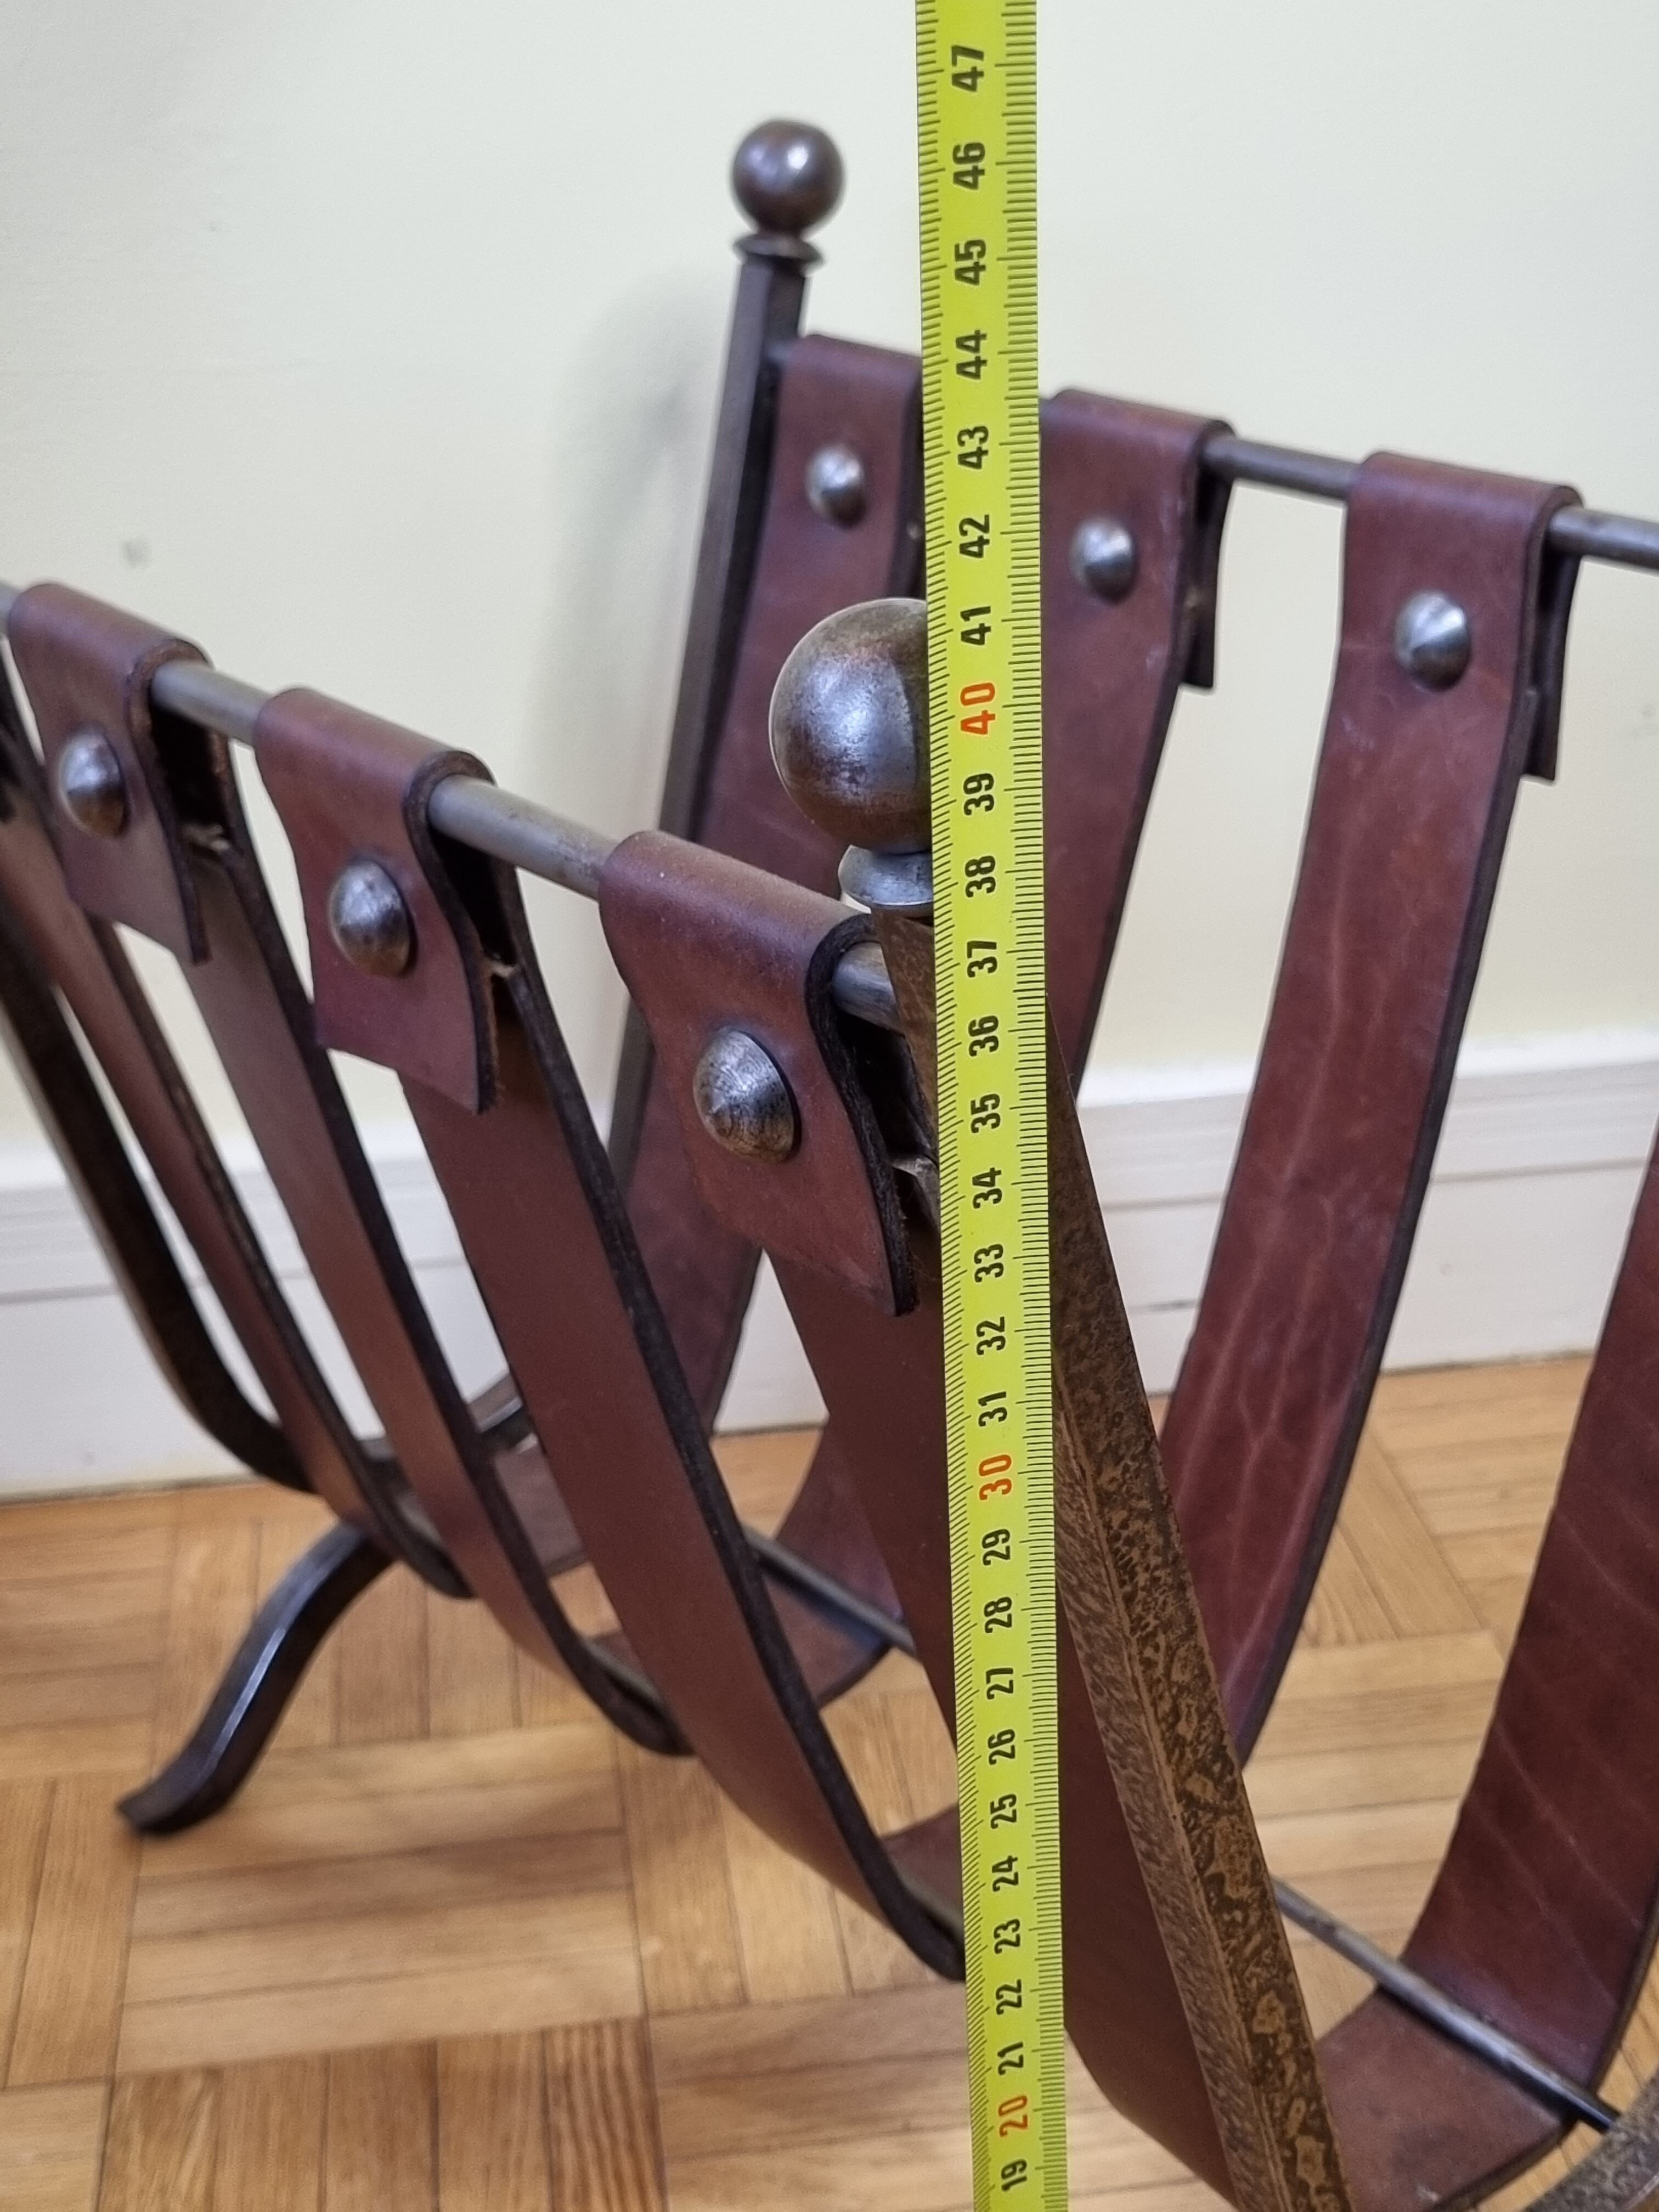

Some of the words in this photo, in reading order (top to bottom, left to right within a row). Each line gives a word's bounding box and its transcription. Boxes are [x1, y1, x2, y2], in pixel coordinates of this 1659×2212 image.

[951, 45, 984, 92] 47
[952, 142, 985, 190] 46
[954, 239, 986, 285] 45
[955, 330, 988, 380] 44
[957, 426, 989, 470] 43
[958, 514, 990, 558] 42
[960, 606, 991, 646] 41
[960, 682, 996, 735] 40
[963, 773, 995, 816] 39
[964, 855, 996, 898] 38
[967, 940, 997, 978] 37
[968, 1015, 999, 1057] 36
[970, 1093, 1001, 1133] 35
[972, 1167, 1002, 1209] 34
[974, 1244, 1004, 1283] 33
[976, 1316, 1006, 1356] 32
[978, 1391, 1008, 1427] 31
[978, 1454, 1012, 1500] 30
[981, 1528, 1011, 1566] 29
[983, 1596, 1012, 1634] 28
[985, 1667, 1014, 1700] 27
[988, 1729, 1015, 1765] 26
[990, 1794, 1017, 1830] 25
[991, 1855, 1019, 1892] 24
[993, 1918, 1021, 1955] 23
[995, 1979, 1022, 2016] 22
[997, 2042, 1024, 2076] 21
[998, 2095, 1028, 2137] 20
[1001, 2159, 1028, 2192] 19
